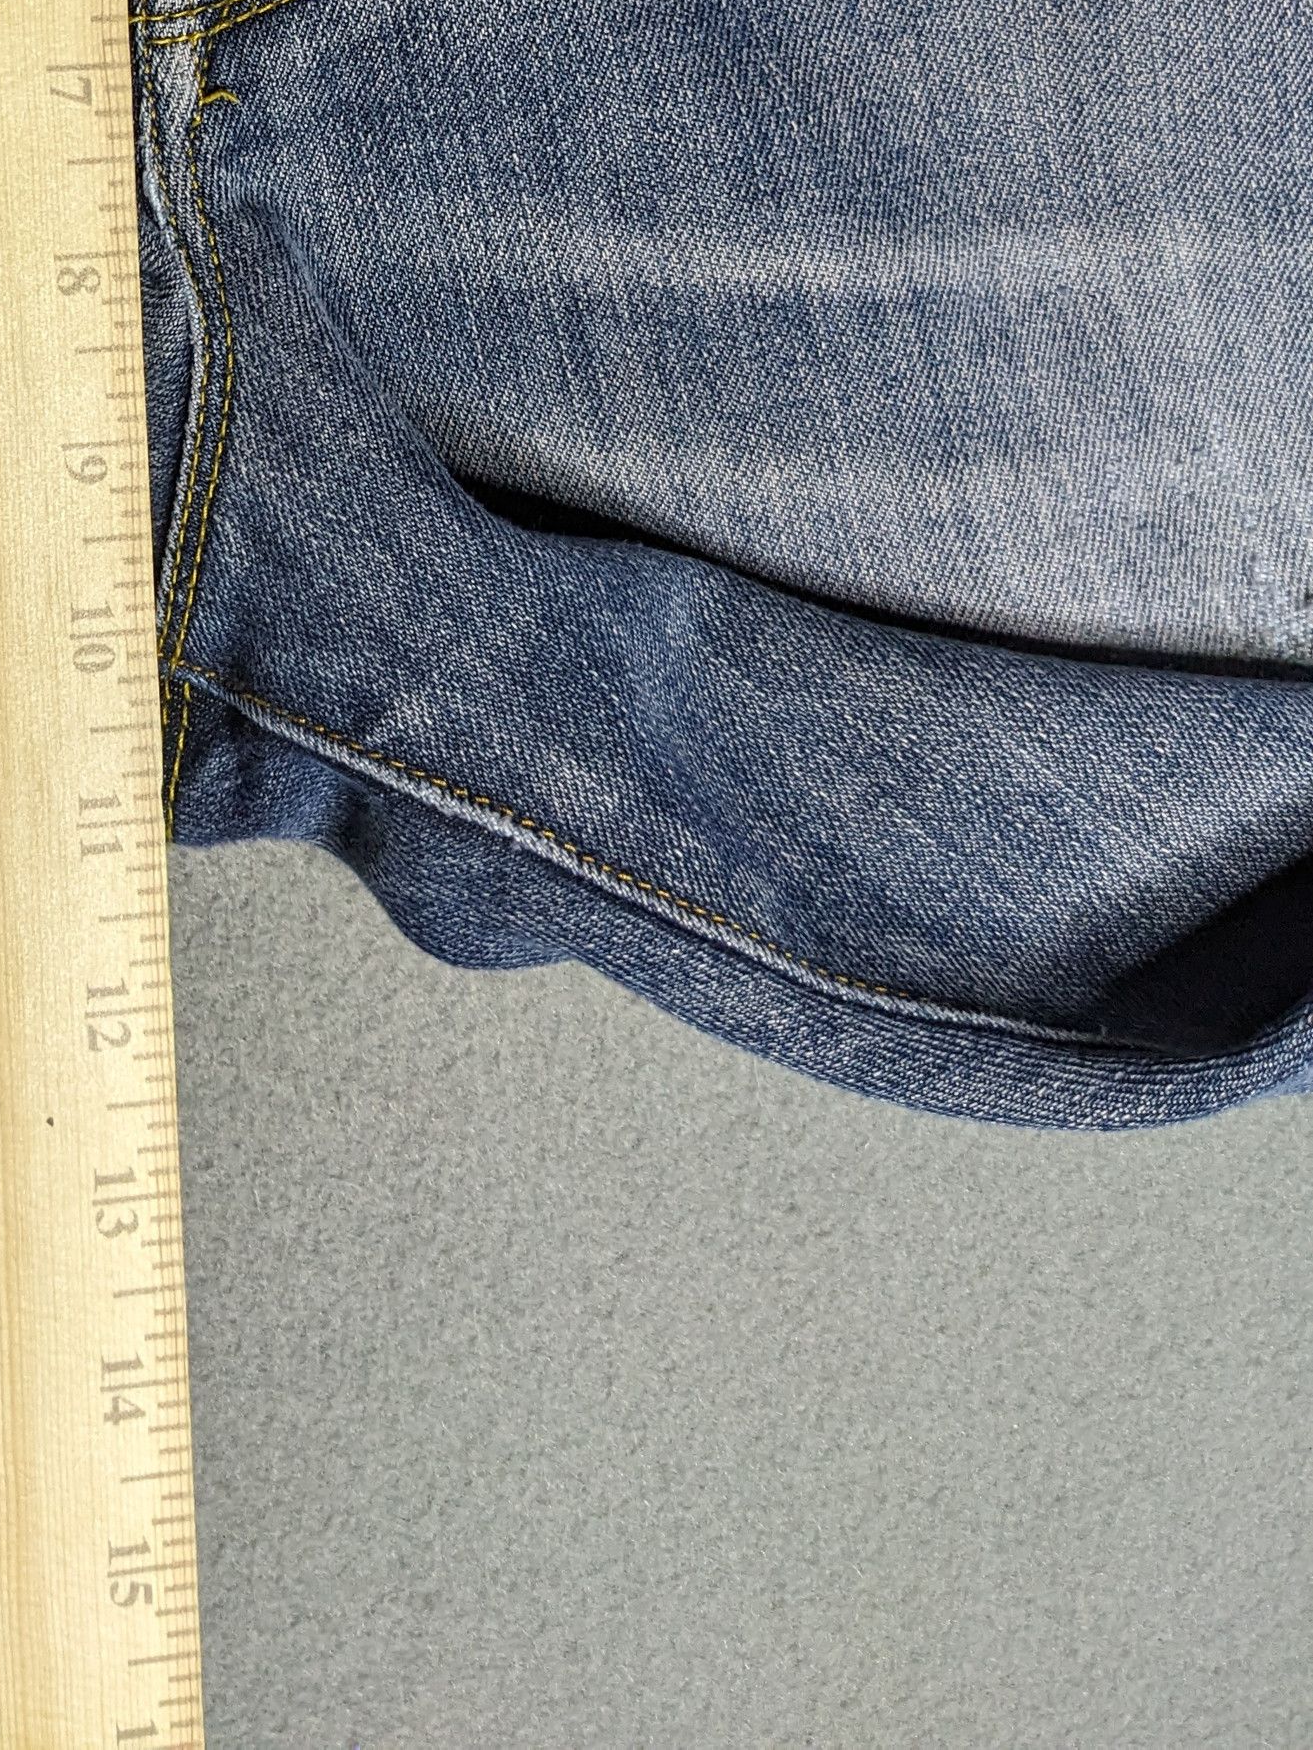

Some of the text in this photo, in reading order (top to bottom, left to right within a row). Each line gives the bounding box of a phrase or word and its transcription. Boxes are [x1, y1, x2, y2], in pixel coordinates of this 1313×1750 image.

[50, 77, 92, 105] 7
[57, 266, 101, 297] 8
[65, 455, 108, 485] 9
[71, 602, 116, 673] 10
[79, 793, 124, 858] 11
[88, 978, 131, 1052] 12
[93, 1167, 139, 1239] 13
[101, 1353, 146, 1426] 14
[108, 1536, 153, 1608] 15
